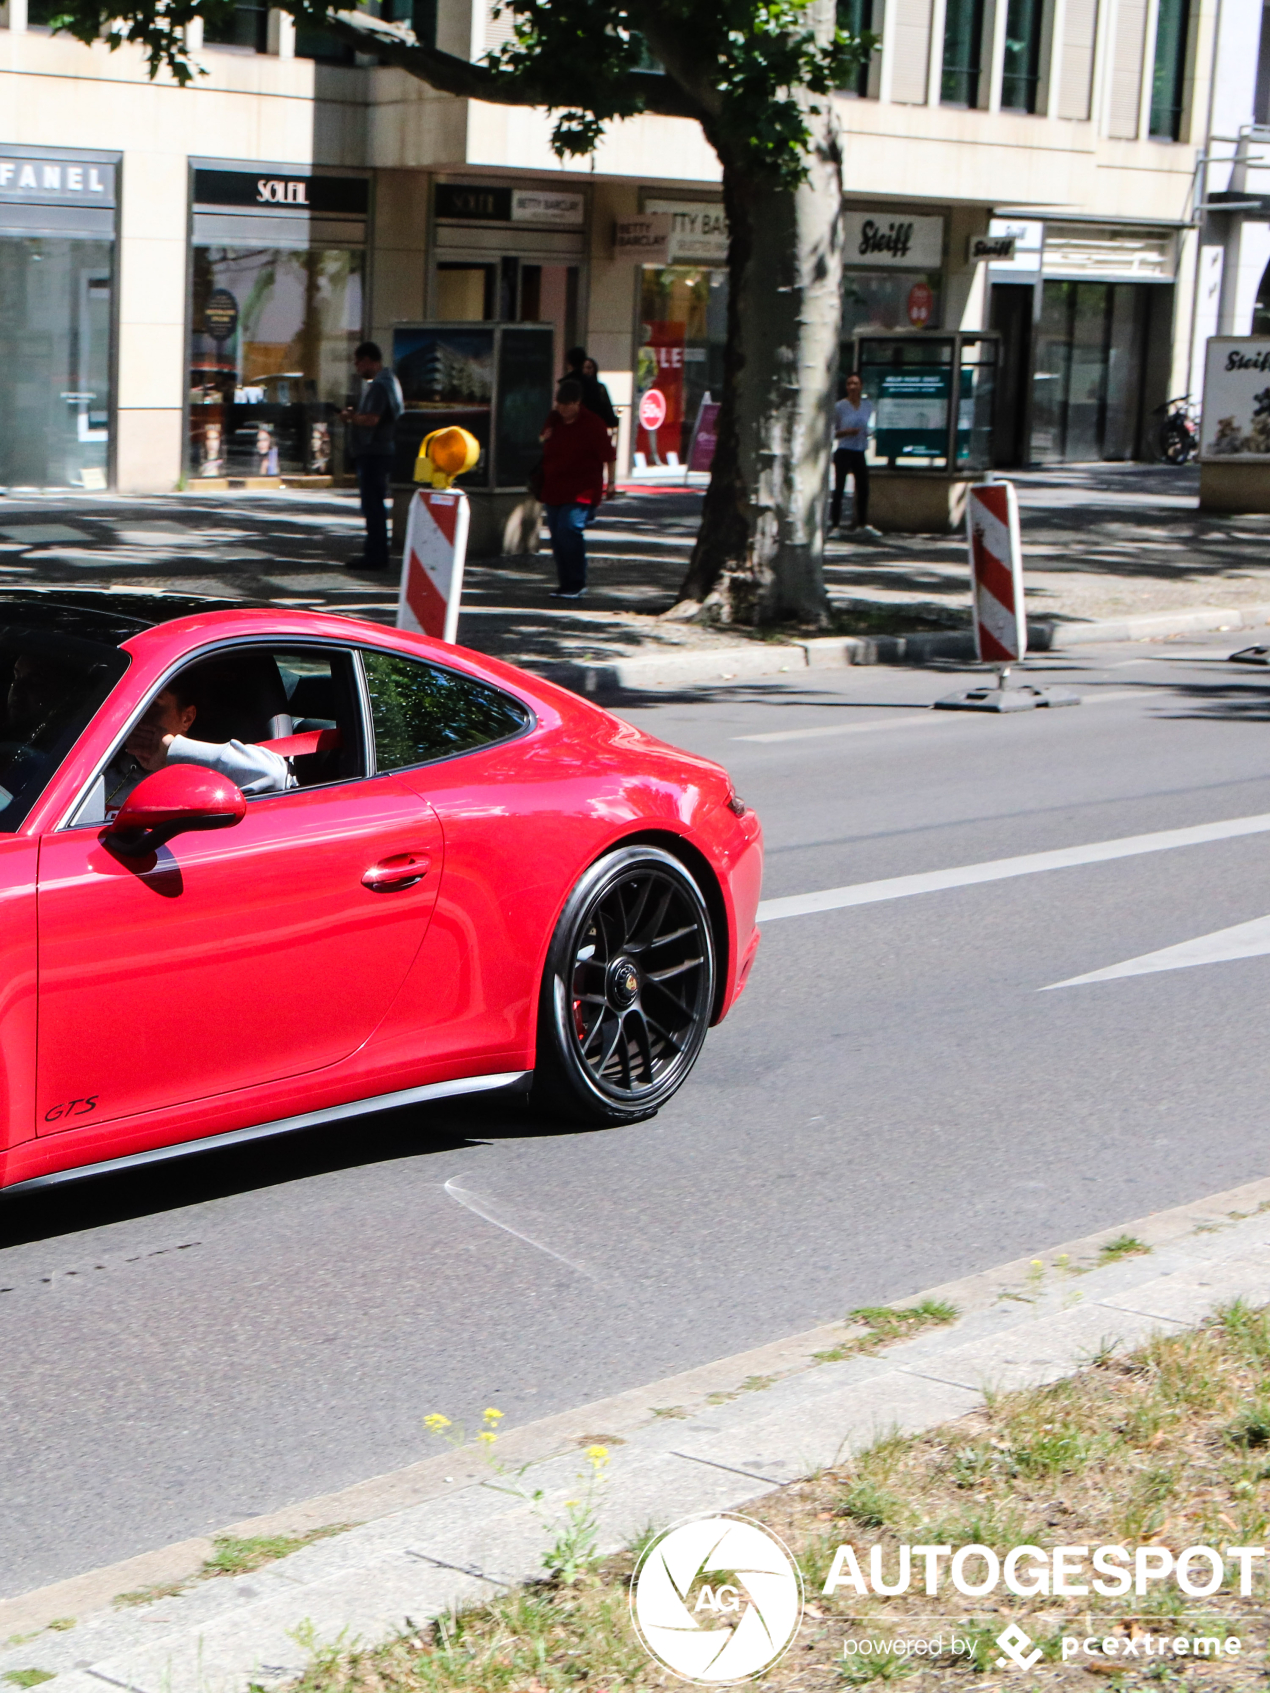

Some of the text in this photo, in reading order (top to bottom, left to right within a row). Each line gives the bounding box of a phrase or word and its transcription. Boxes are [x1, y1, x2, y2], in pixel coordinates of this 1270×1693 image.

[858, 219, 914, 258] Steiff
[973, 239, 1014, 257] Steiff
[1225, 350, 1270, 372] Steif
[44, 1094, 99, 1122] GTS
